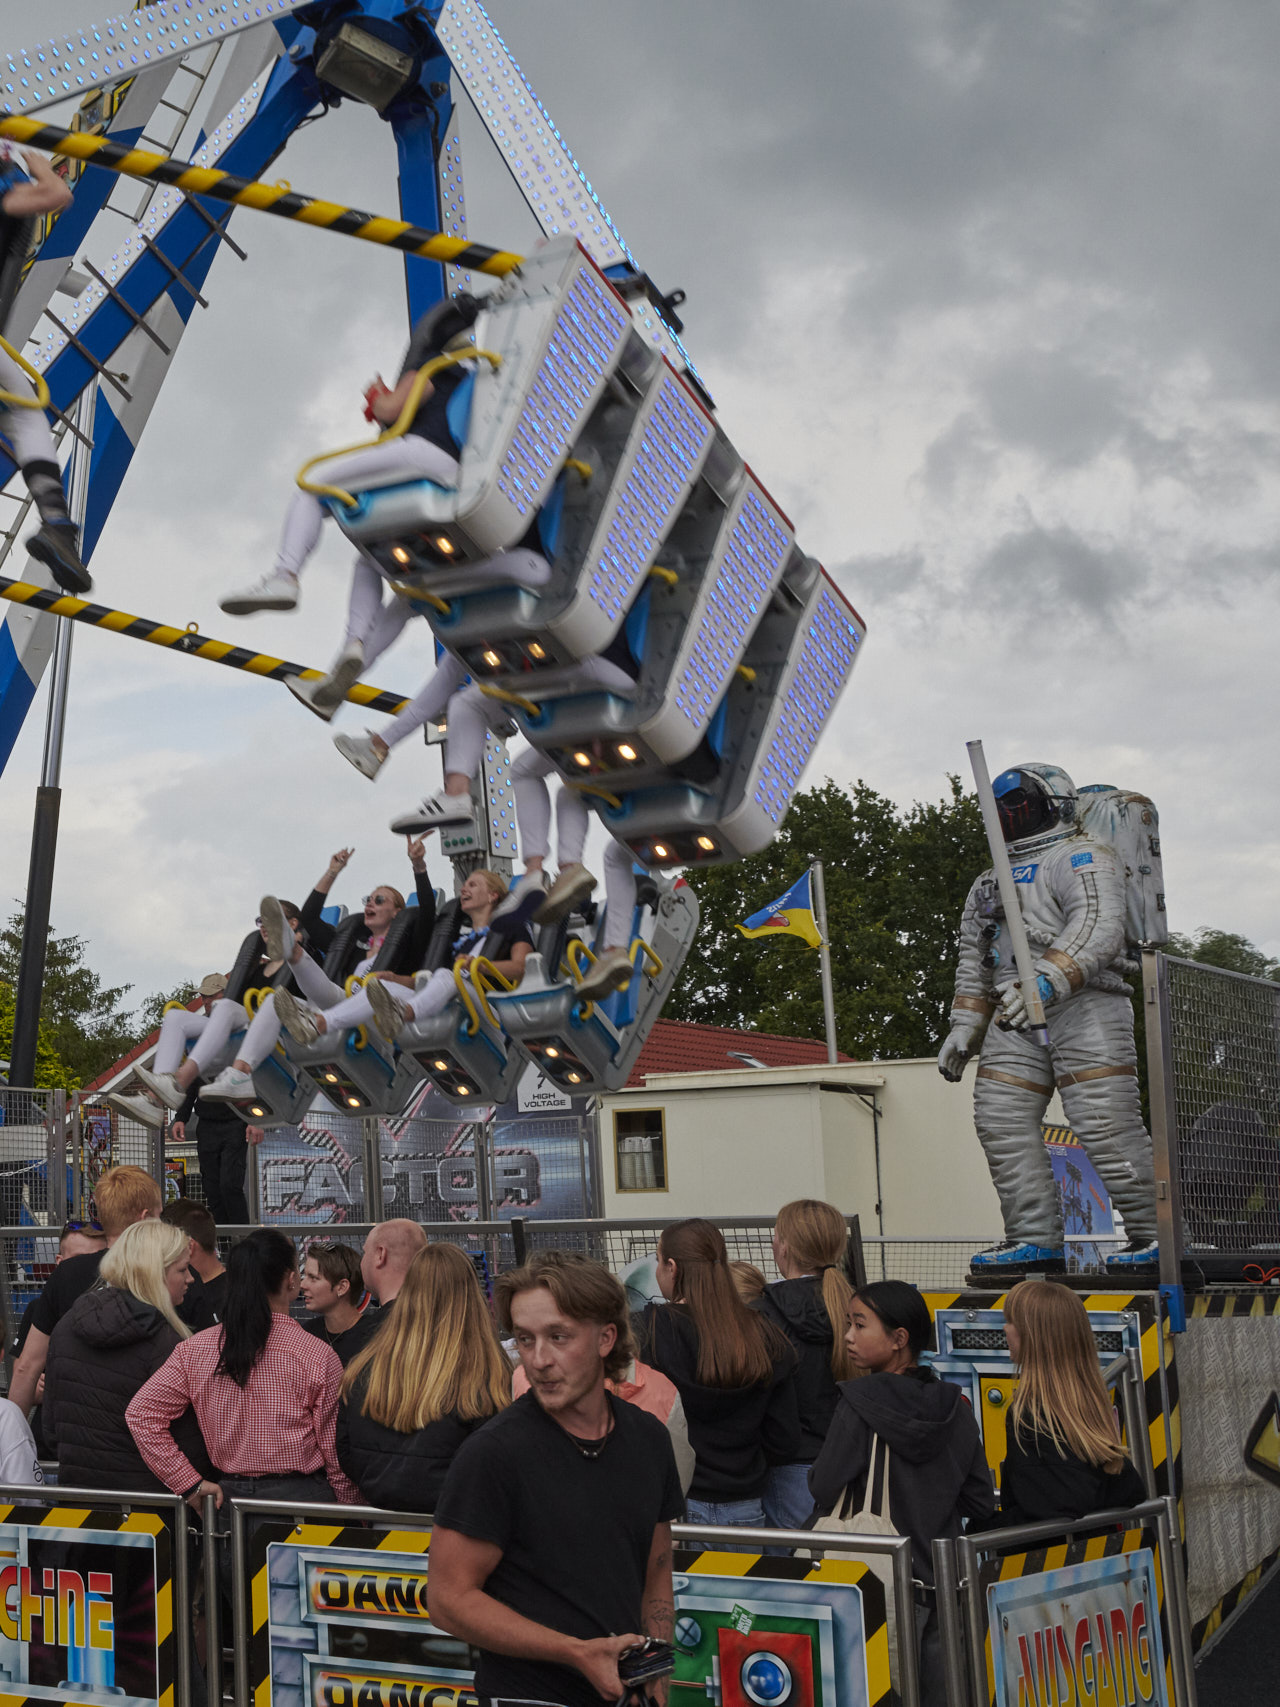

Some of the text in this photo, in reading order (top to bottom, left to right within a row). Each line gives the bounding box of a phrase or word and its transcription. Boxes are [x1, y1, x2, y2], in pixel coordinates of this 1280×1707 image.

[523, 1099, 567, 1109] VOLTAGE
[532, 1092, 557, 1101] HIGH
[264, 1151, 541, 1211] FACTOR
[319, 1570, 429, 1615] DAN
[1016, 1600, 1154, 1707] AUSGANG
